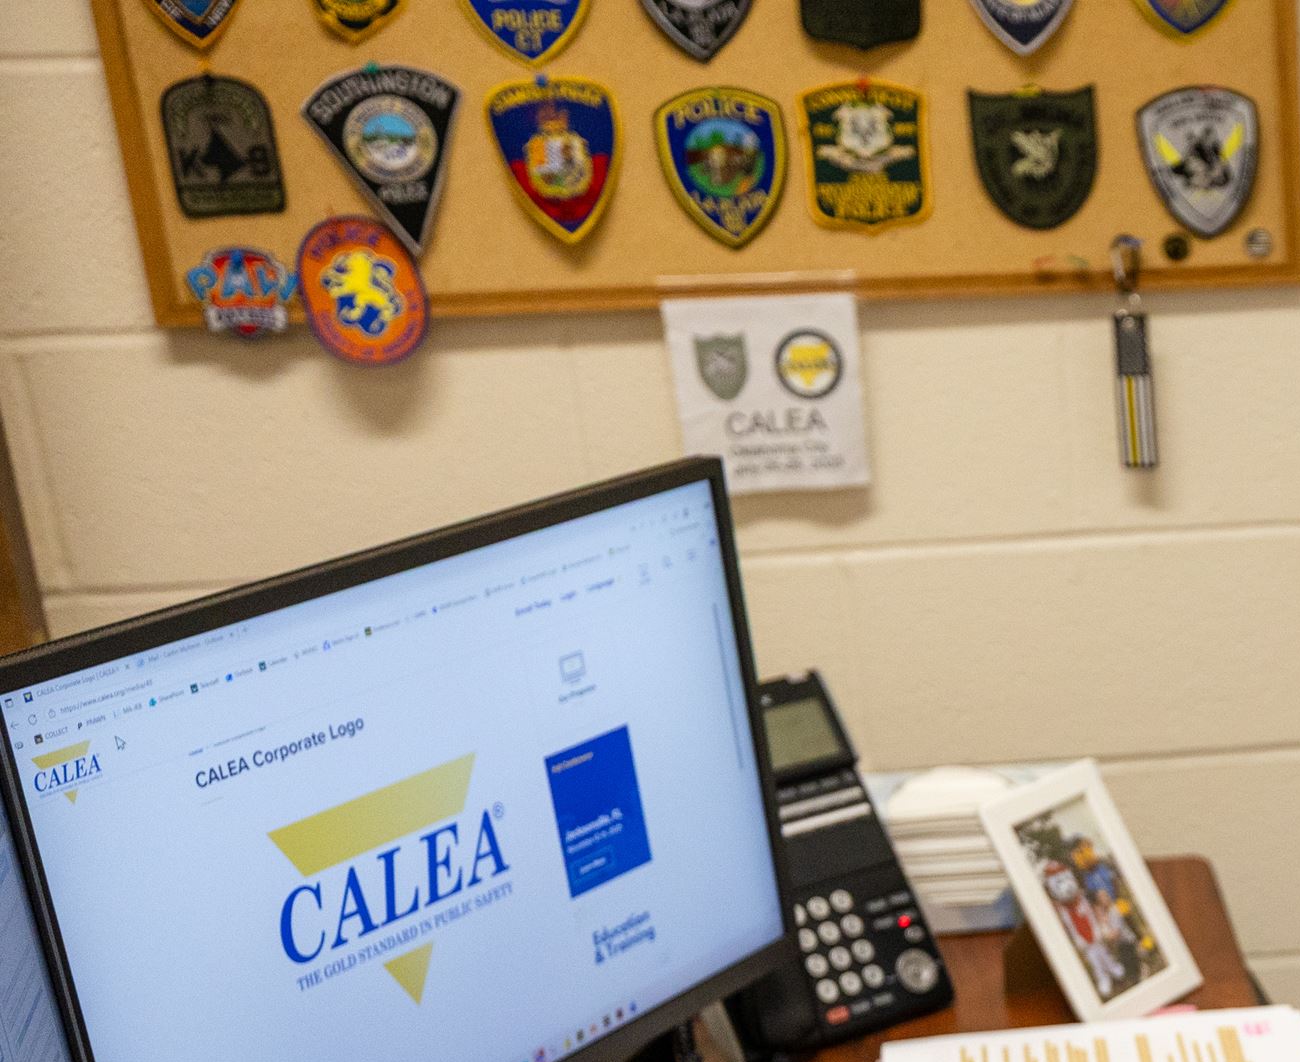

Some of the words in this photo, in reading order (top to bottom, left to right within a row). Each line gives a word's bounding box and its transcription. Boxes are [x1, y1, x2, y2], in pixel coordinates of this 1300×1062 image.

[490, 8, 564, 32] POLICE
[309, 70, 450, 125] SOUTHINGTON
[674, 97, 764, 129] POLICE
[724, 407, 829, 436] CALEA
[34, 754, 102, 793] CALEA
[195, 757, 250, 788] CALEA
[252, 730, 326, 768] Corporate
[328, 717, 365, 741] Logo
[280, 808, 510, 964] CALEA
[296, 970, 324, 992] THE
[323, 954, 357, 979] GOLD
[358, 925, 419, 965] STANDARD
[420, 919, 432, 936] IN
[433, 899, 473, 928] PUBLIC
[474, 881, 514, 909] SAFETY
